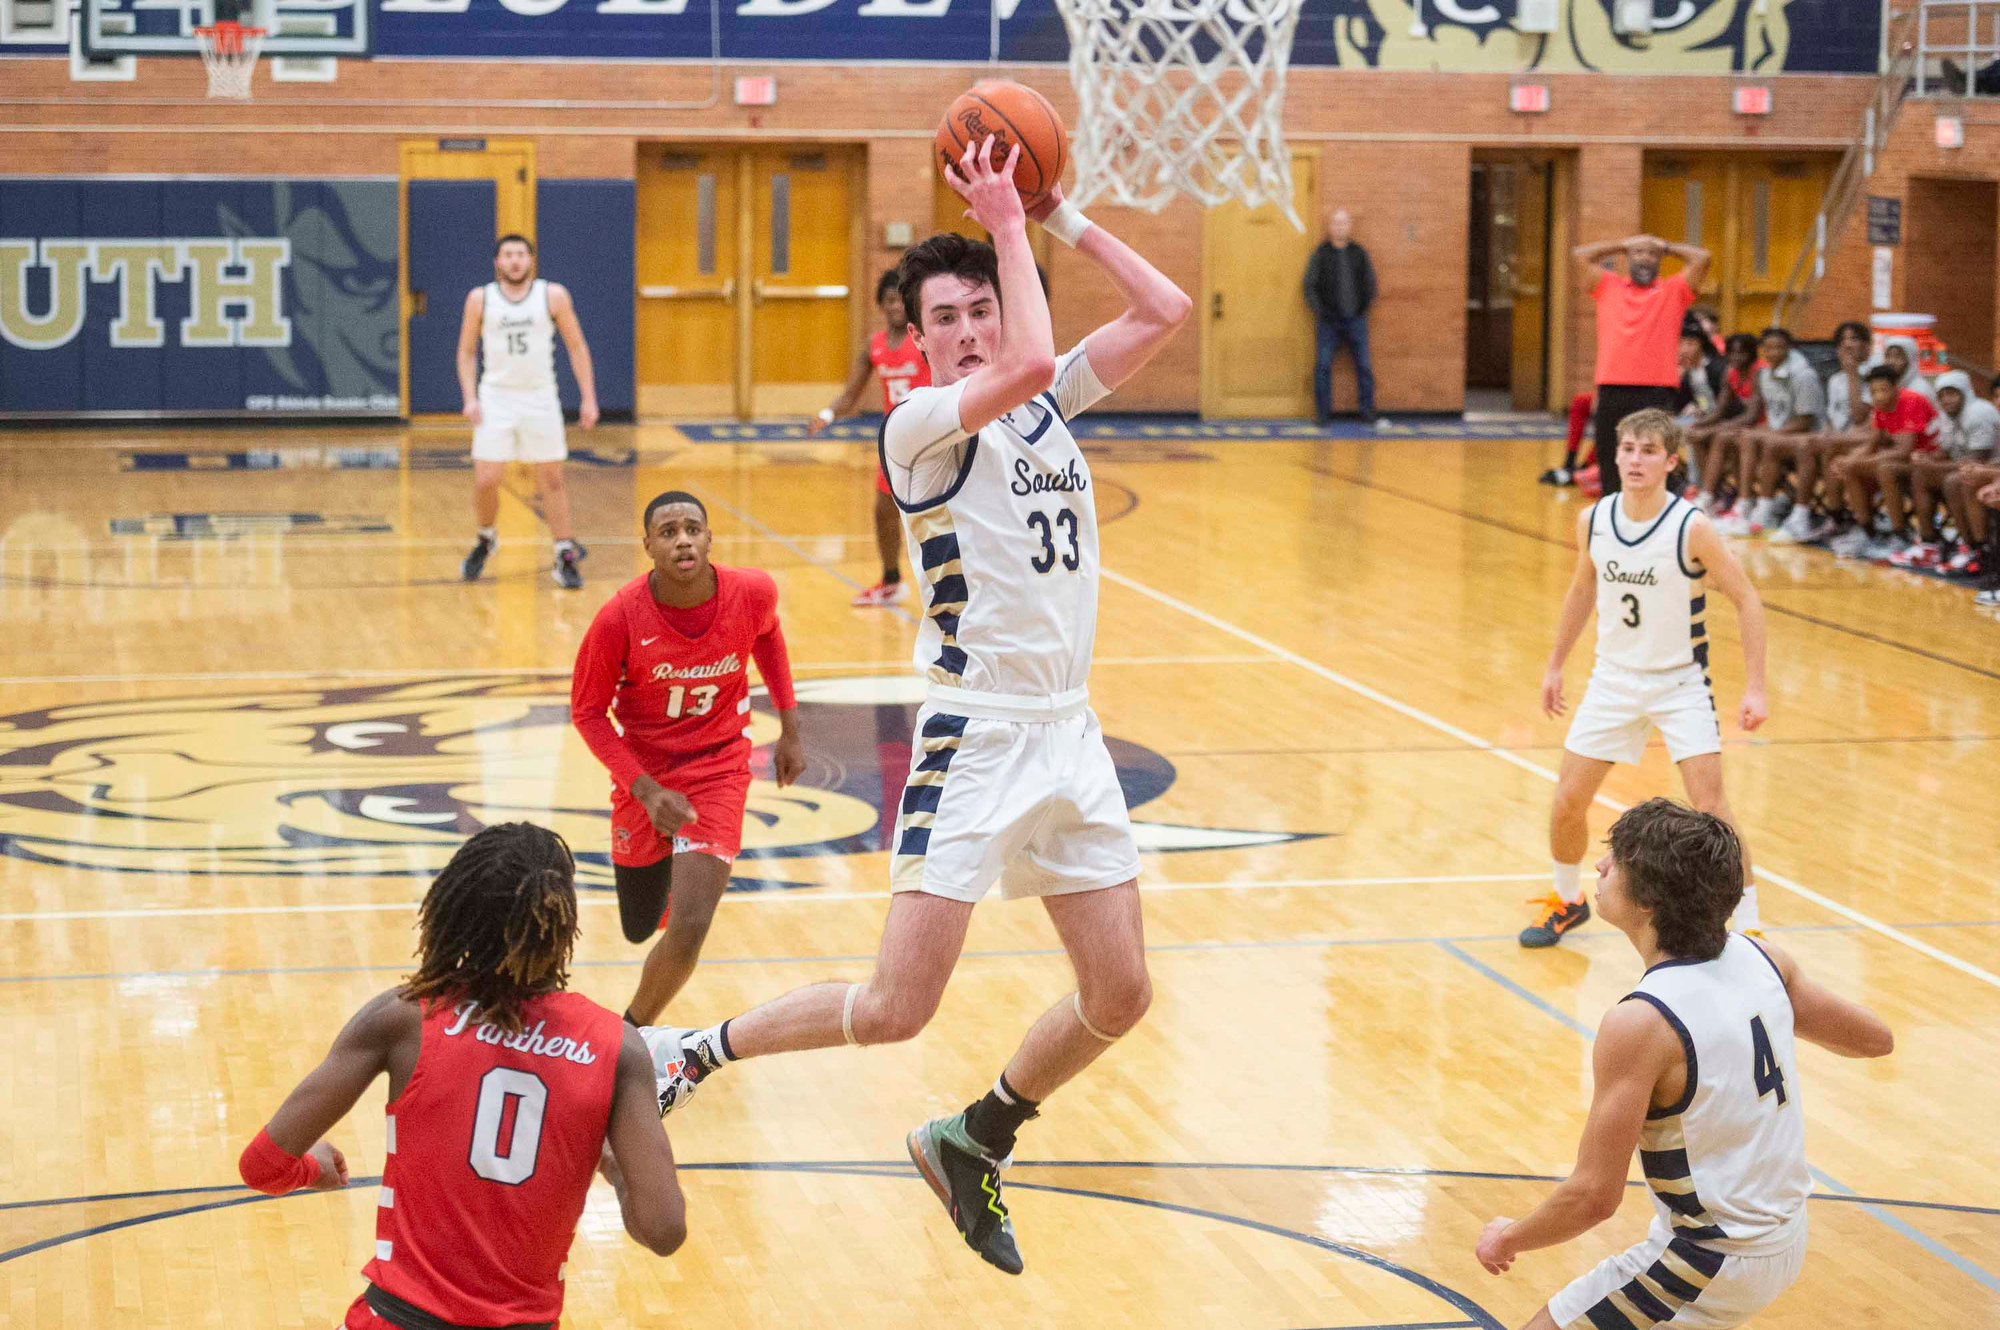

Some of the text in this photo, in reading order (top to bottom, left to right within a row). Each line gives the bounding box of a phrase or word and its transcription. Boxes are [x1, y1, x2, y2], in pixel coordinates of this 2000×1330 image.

[0, 238, 292, 350] UTH
[507, 331, 529, 355] 15
[1010, 457, 1087, 496] South
[1026, 508, 1081, 575] 33
[1603, 560, 1659, 586] South
[1621, 593, 1642, 629] 3
[648, 652, 741, 683] Roseville
[666, 684, 720, 719] 13
[1749, 1012, 1790, 1113] 4
[469, 1065, 549, 1186] 0
